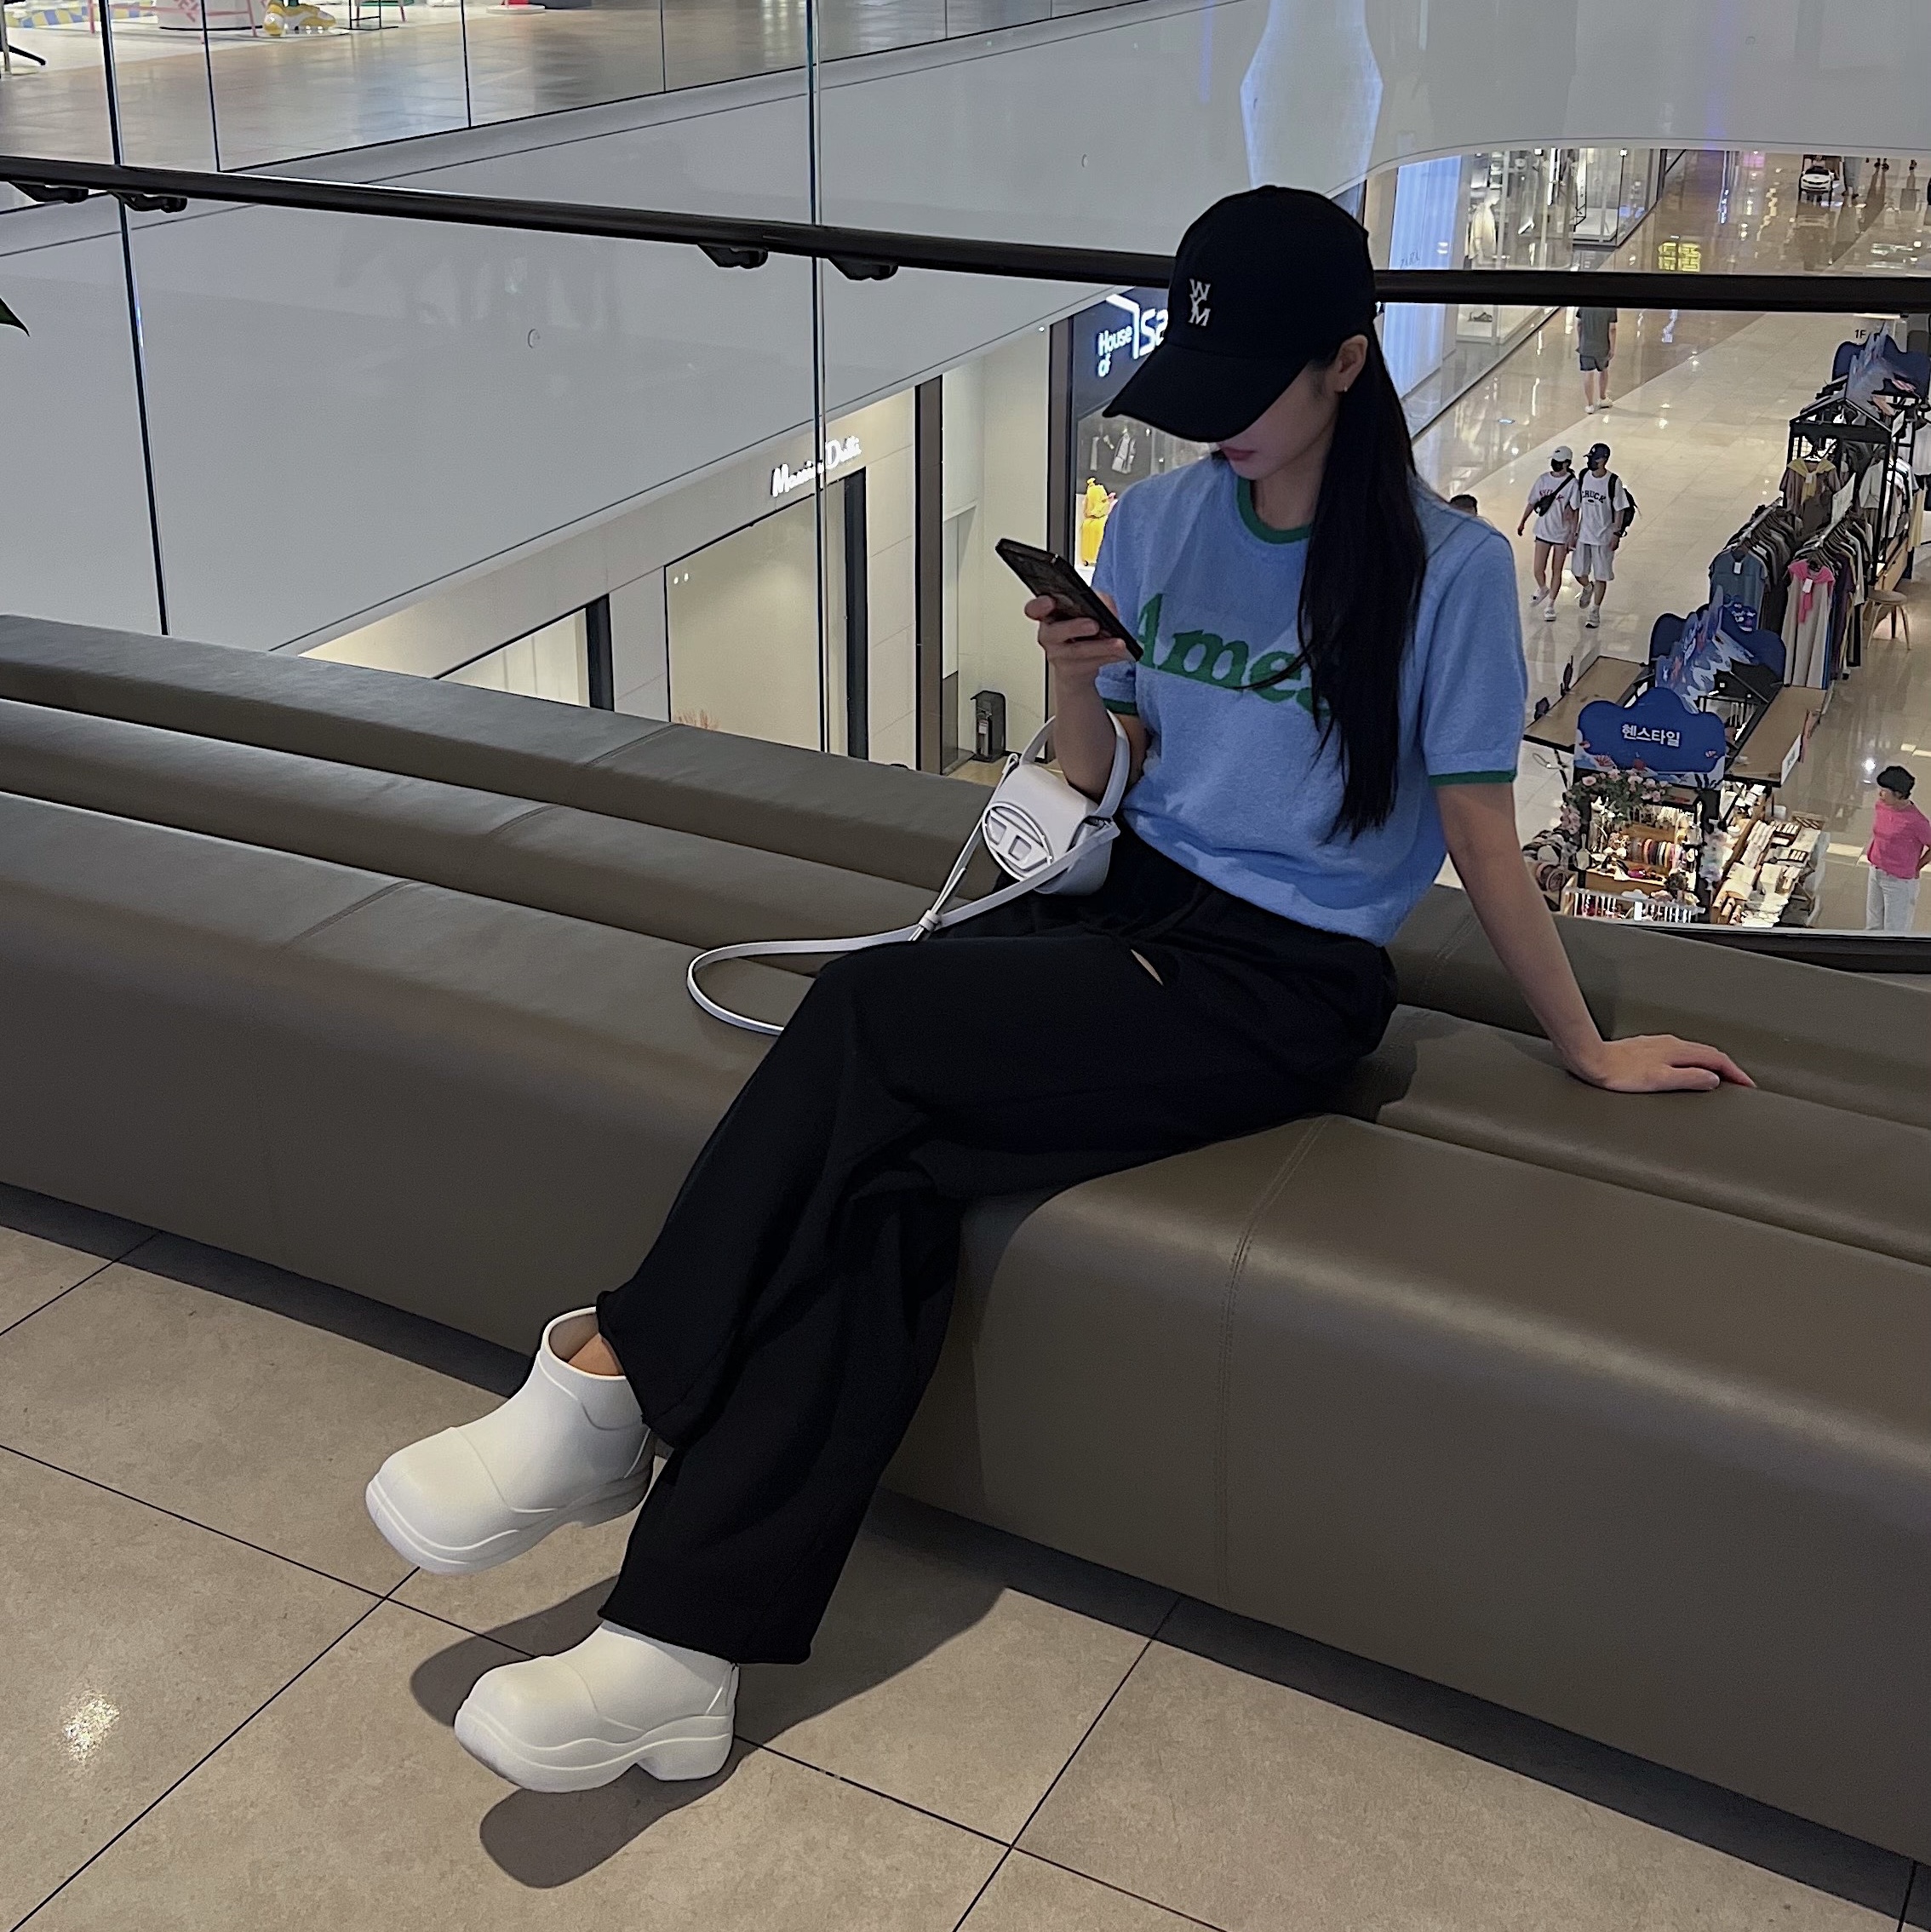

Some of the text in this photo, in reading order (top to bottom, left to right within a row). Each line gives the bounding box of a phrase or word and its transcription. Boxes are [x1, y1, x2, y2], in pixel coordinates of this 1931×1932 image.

[1097, 325, 1132, 357] House
[1854, 329, 1866, 340] 1F
[1097, 353, 1111, 377] of
